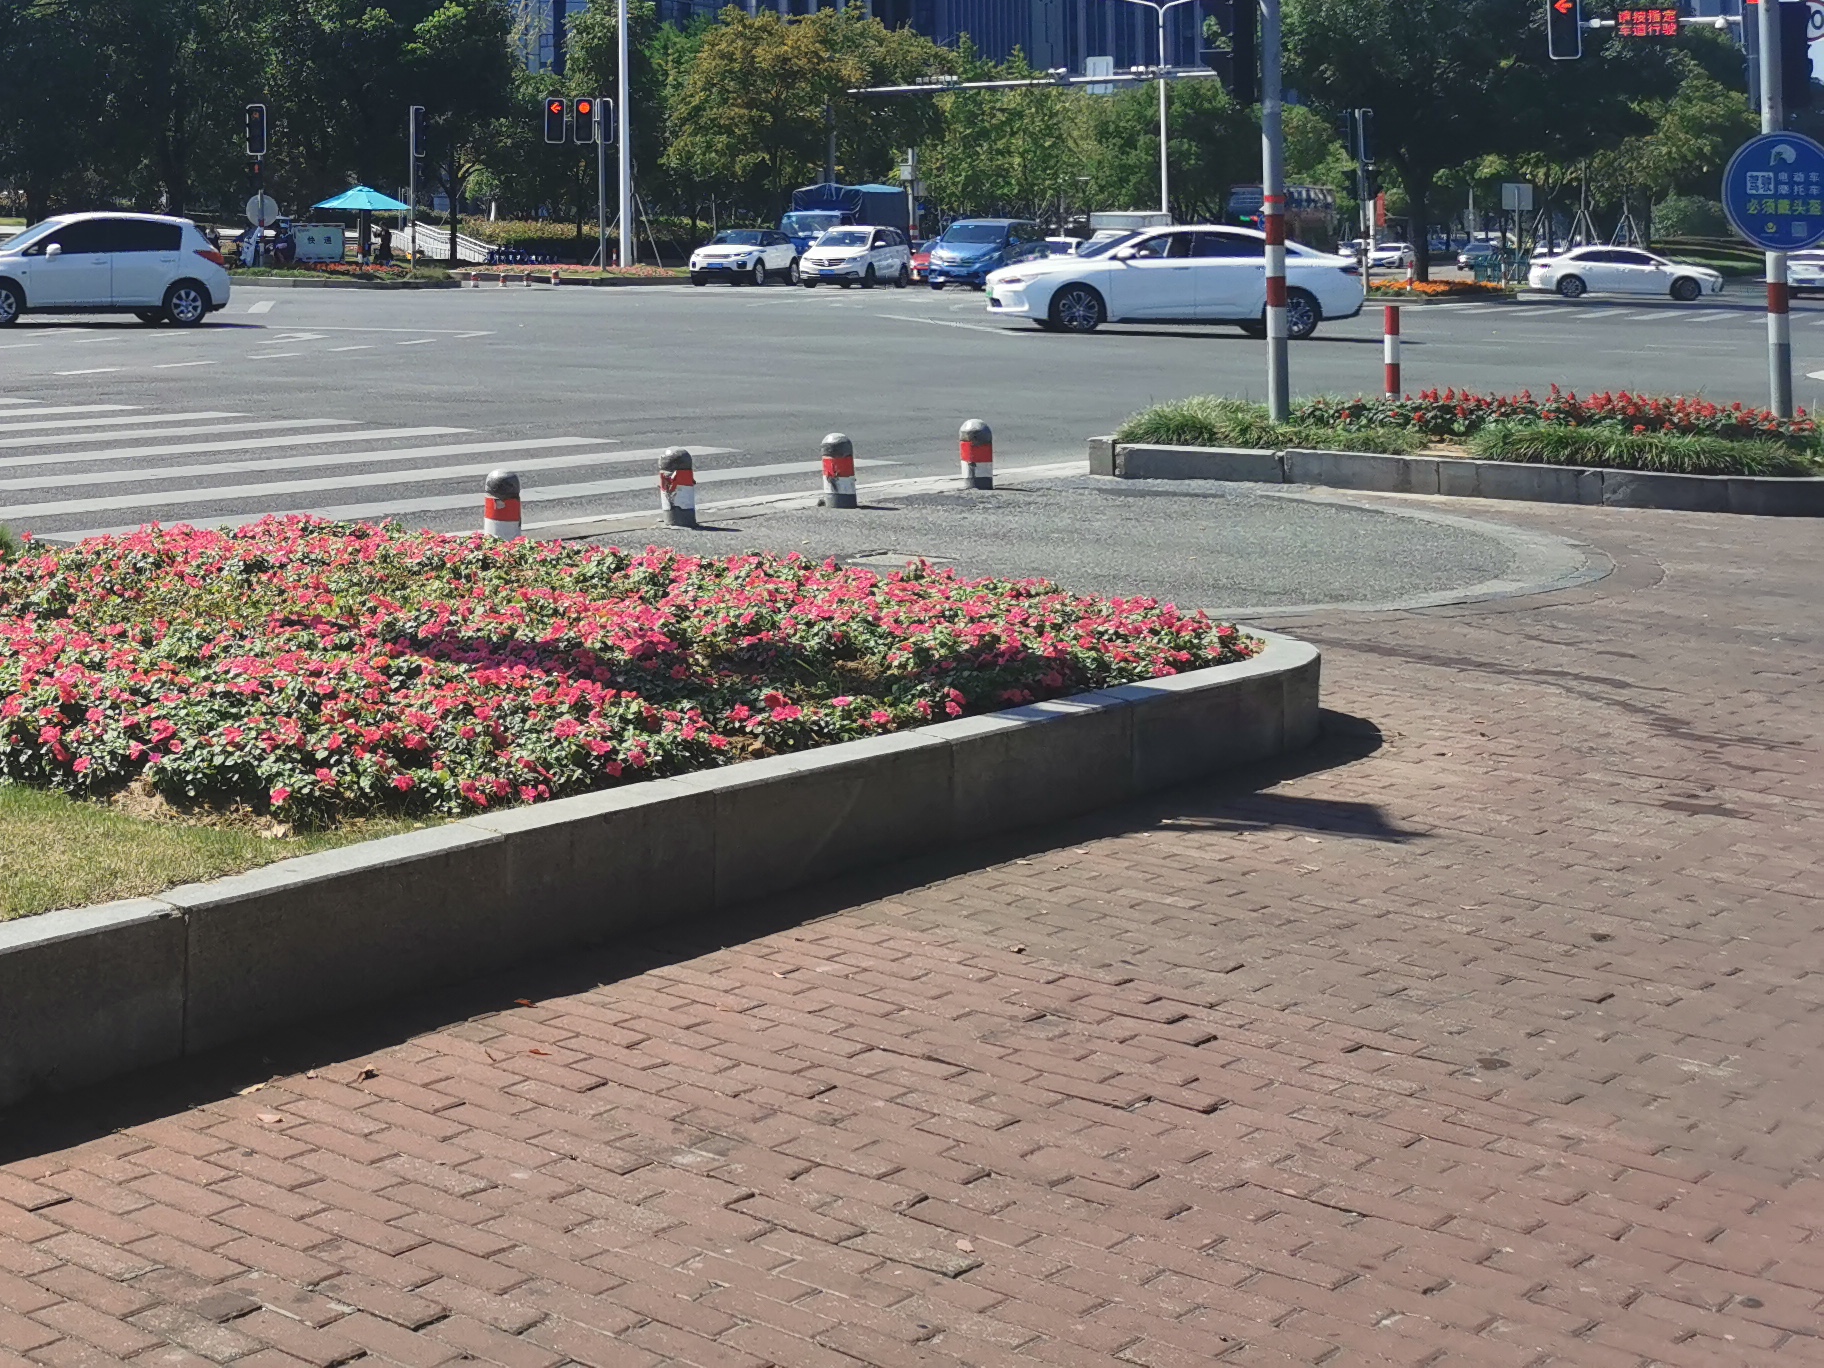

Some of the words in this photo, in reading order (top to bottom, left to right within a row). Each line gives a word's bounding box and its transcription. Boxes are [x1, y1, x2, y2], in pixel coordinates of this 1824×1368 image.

[1617, 10, 1677, 23] 请按指定
[1617, 23, 1677, 37] 车道行驶
[1748, 174, 1773, 192] 驾驶
[1778, 172, 1820, 183] 电动车
[1746, 199, 1822, 215] 必须戴头盔
